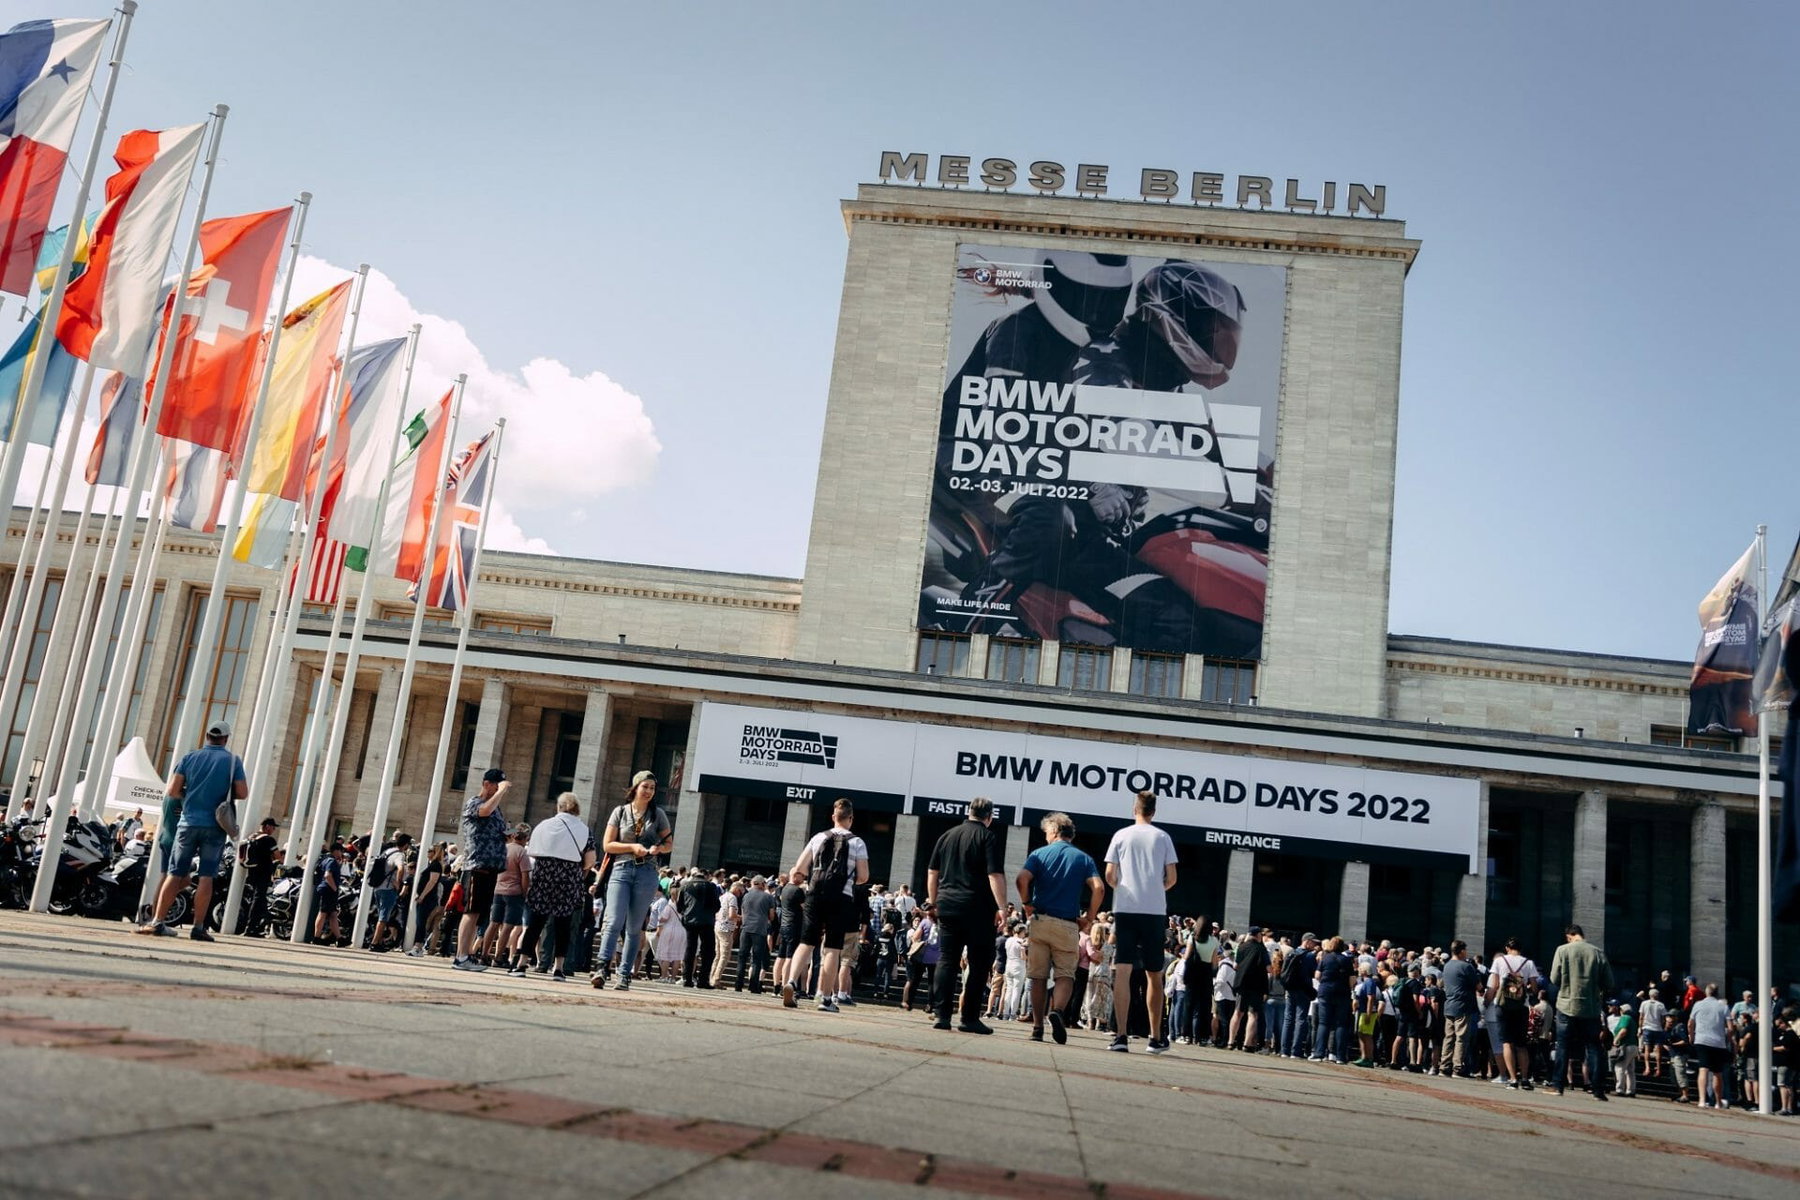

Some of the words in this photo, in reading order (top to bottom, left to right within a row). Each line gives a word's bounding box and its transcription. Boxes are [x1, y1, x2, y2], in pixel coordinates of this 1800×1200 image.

[879, 151, 1109, 195] MESSE
[1140, 168, 1386, 214] BERLIN
[996, 269, 1022, 279] BMW
[995, 278, 1053, 290] MOTORRAD
[959, 375, 1074, 413] BMW
[954, 407, 1214, 457] MOTORRAD
[952, 440, 1064, 480] DAYS
[949, 476, 1005, 493] 02.-03.
[1008, 481, 1043, 497] JULI
[1046, 484, 1089, 500] 2022
[936, 597, 962, 607] MAKE
[963, 599, 982, 609] LIFE
[990, 602, 1012, 611] RIDE
[743, 724, 780, 738] BMW
[740, 747, 776, 761] DAYS
[741, 736, 823, 754] MOTORRAD
[134, 786, 162, 794] CHECK-IN
[786, 786, 816, 799] EXIT
[955, 751, 1043, 783] BMW
[1049, 761, 1247, 804] MOTORRAD
[1255, 782, 1339, 815] DAYS
[1347, 792, 1431, 825] 2022
[928, 801, 963, 815] FAST
[964, 805, 1000, 819] LE
[1205, 831, 1281, 850] ENTRANCE
